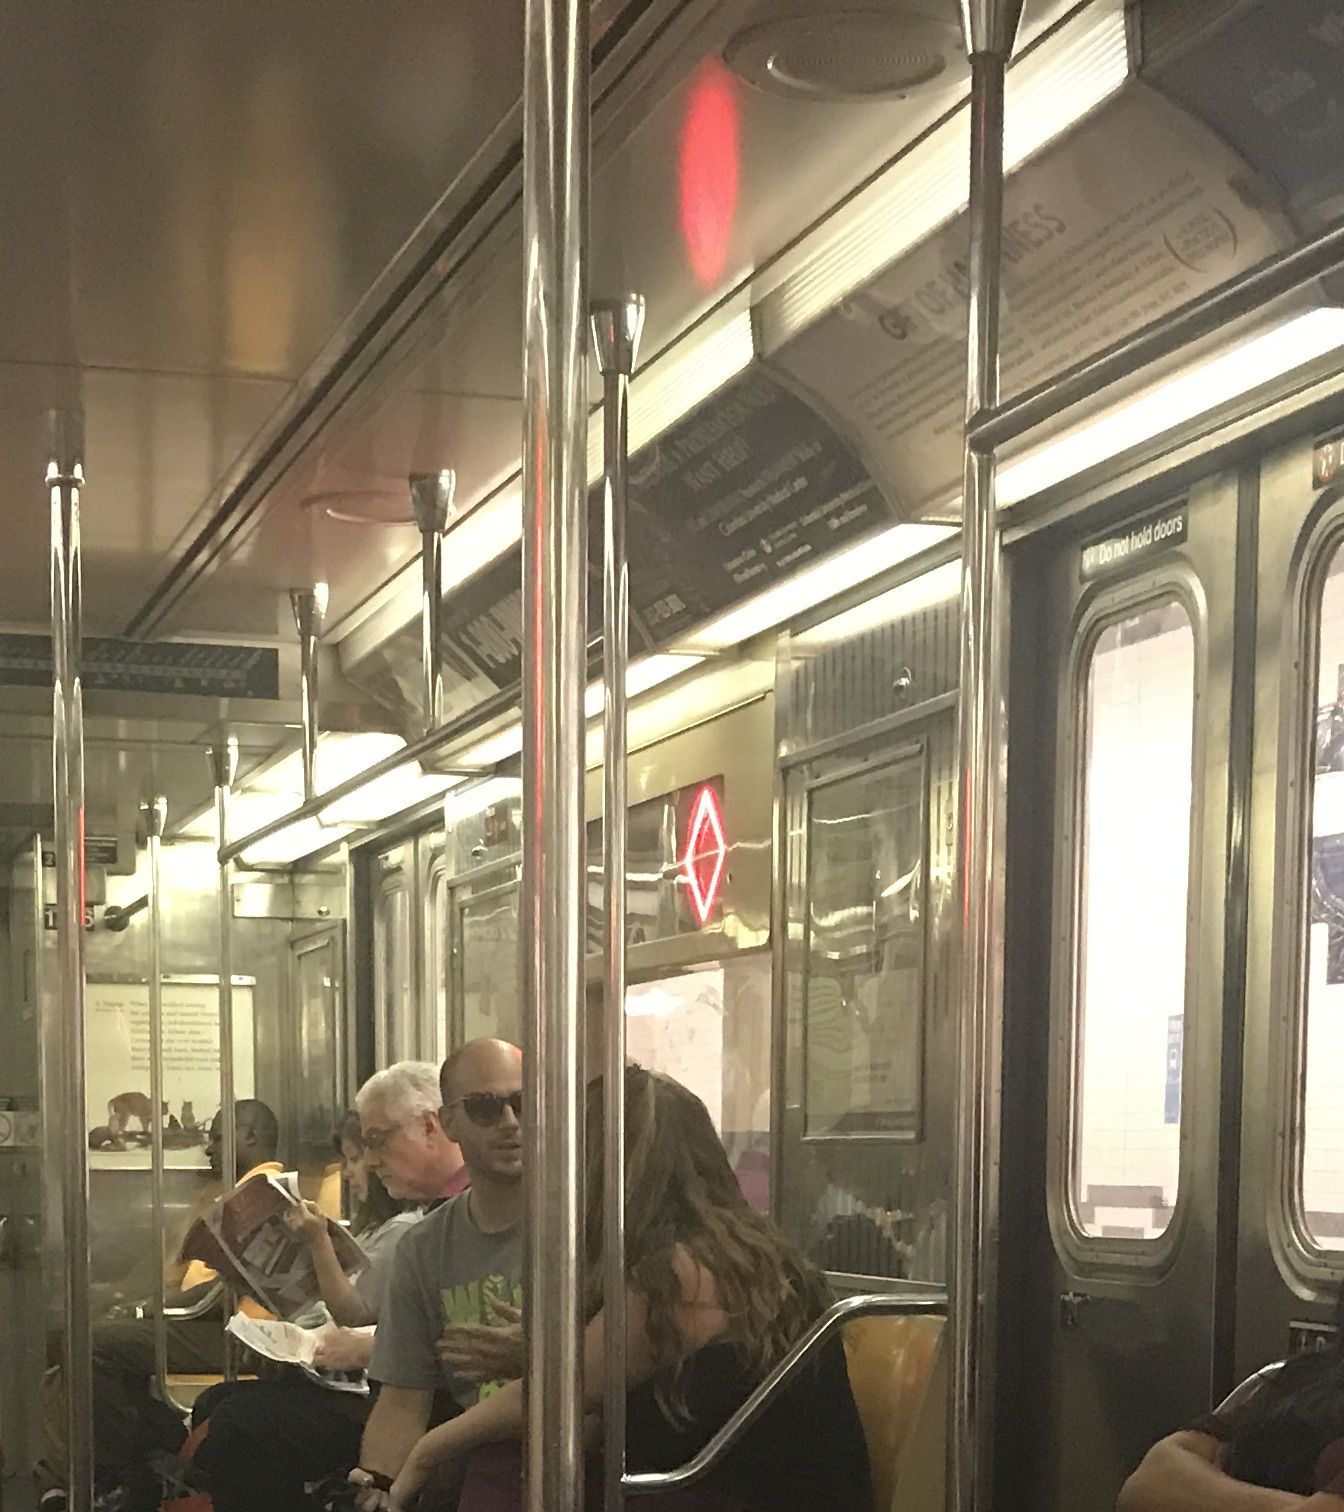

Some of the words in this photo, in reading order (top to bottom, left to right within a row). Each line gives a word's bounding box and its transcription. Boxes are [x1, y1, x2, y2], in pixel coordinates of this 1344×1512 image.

[1099, 544, 1112, 565] Do
[1113, 535, 1129, 559] not
[1130, 524, 1153, 551] hold
[1153, 515, 1183, 542] doors
